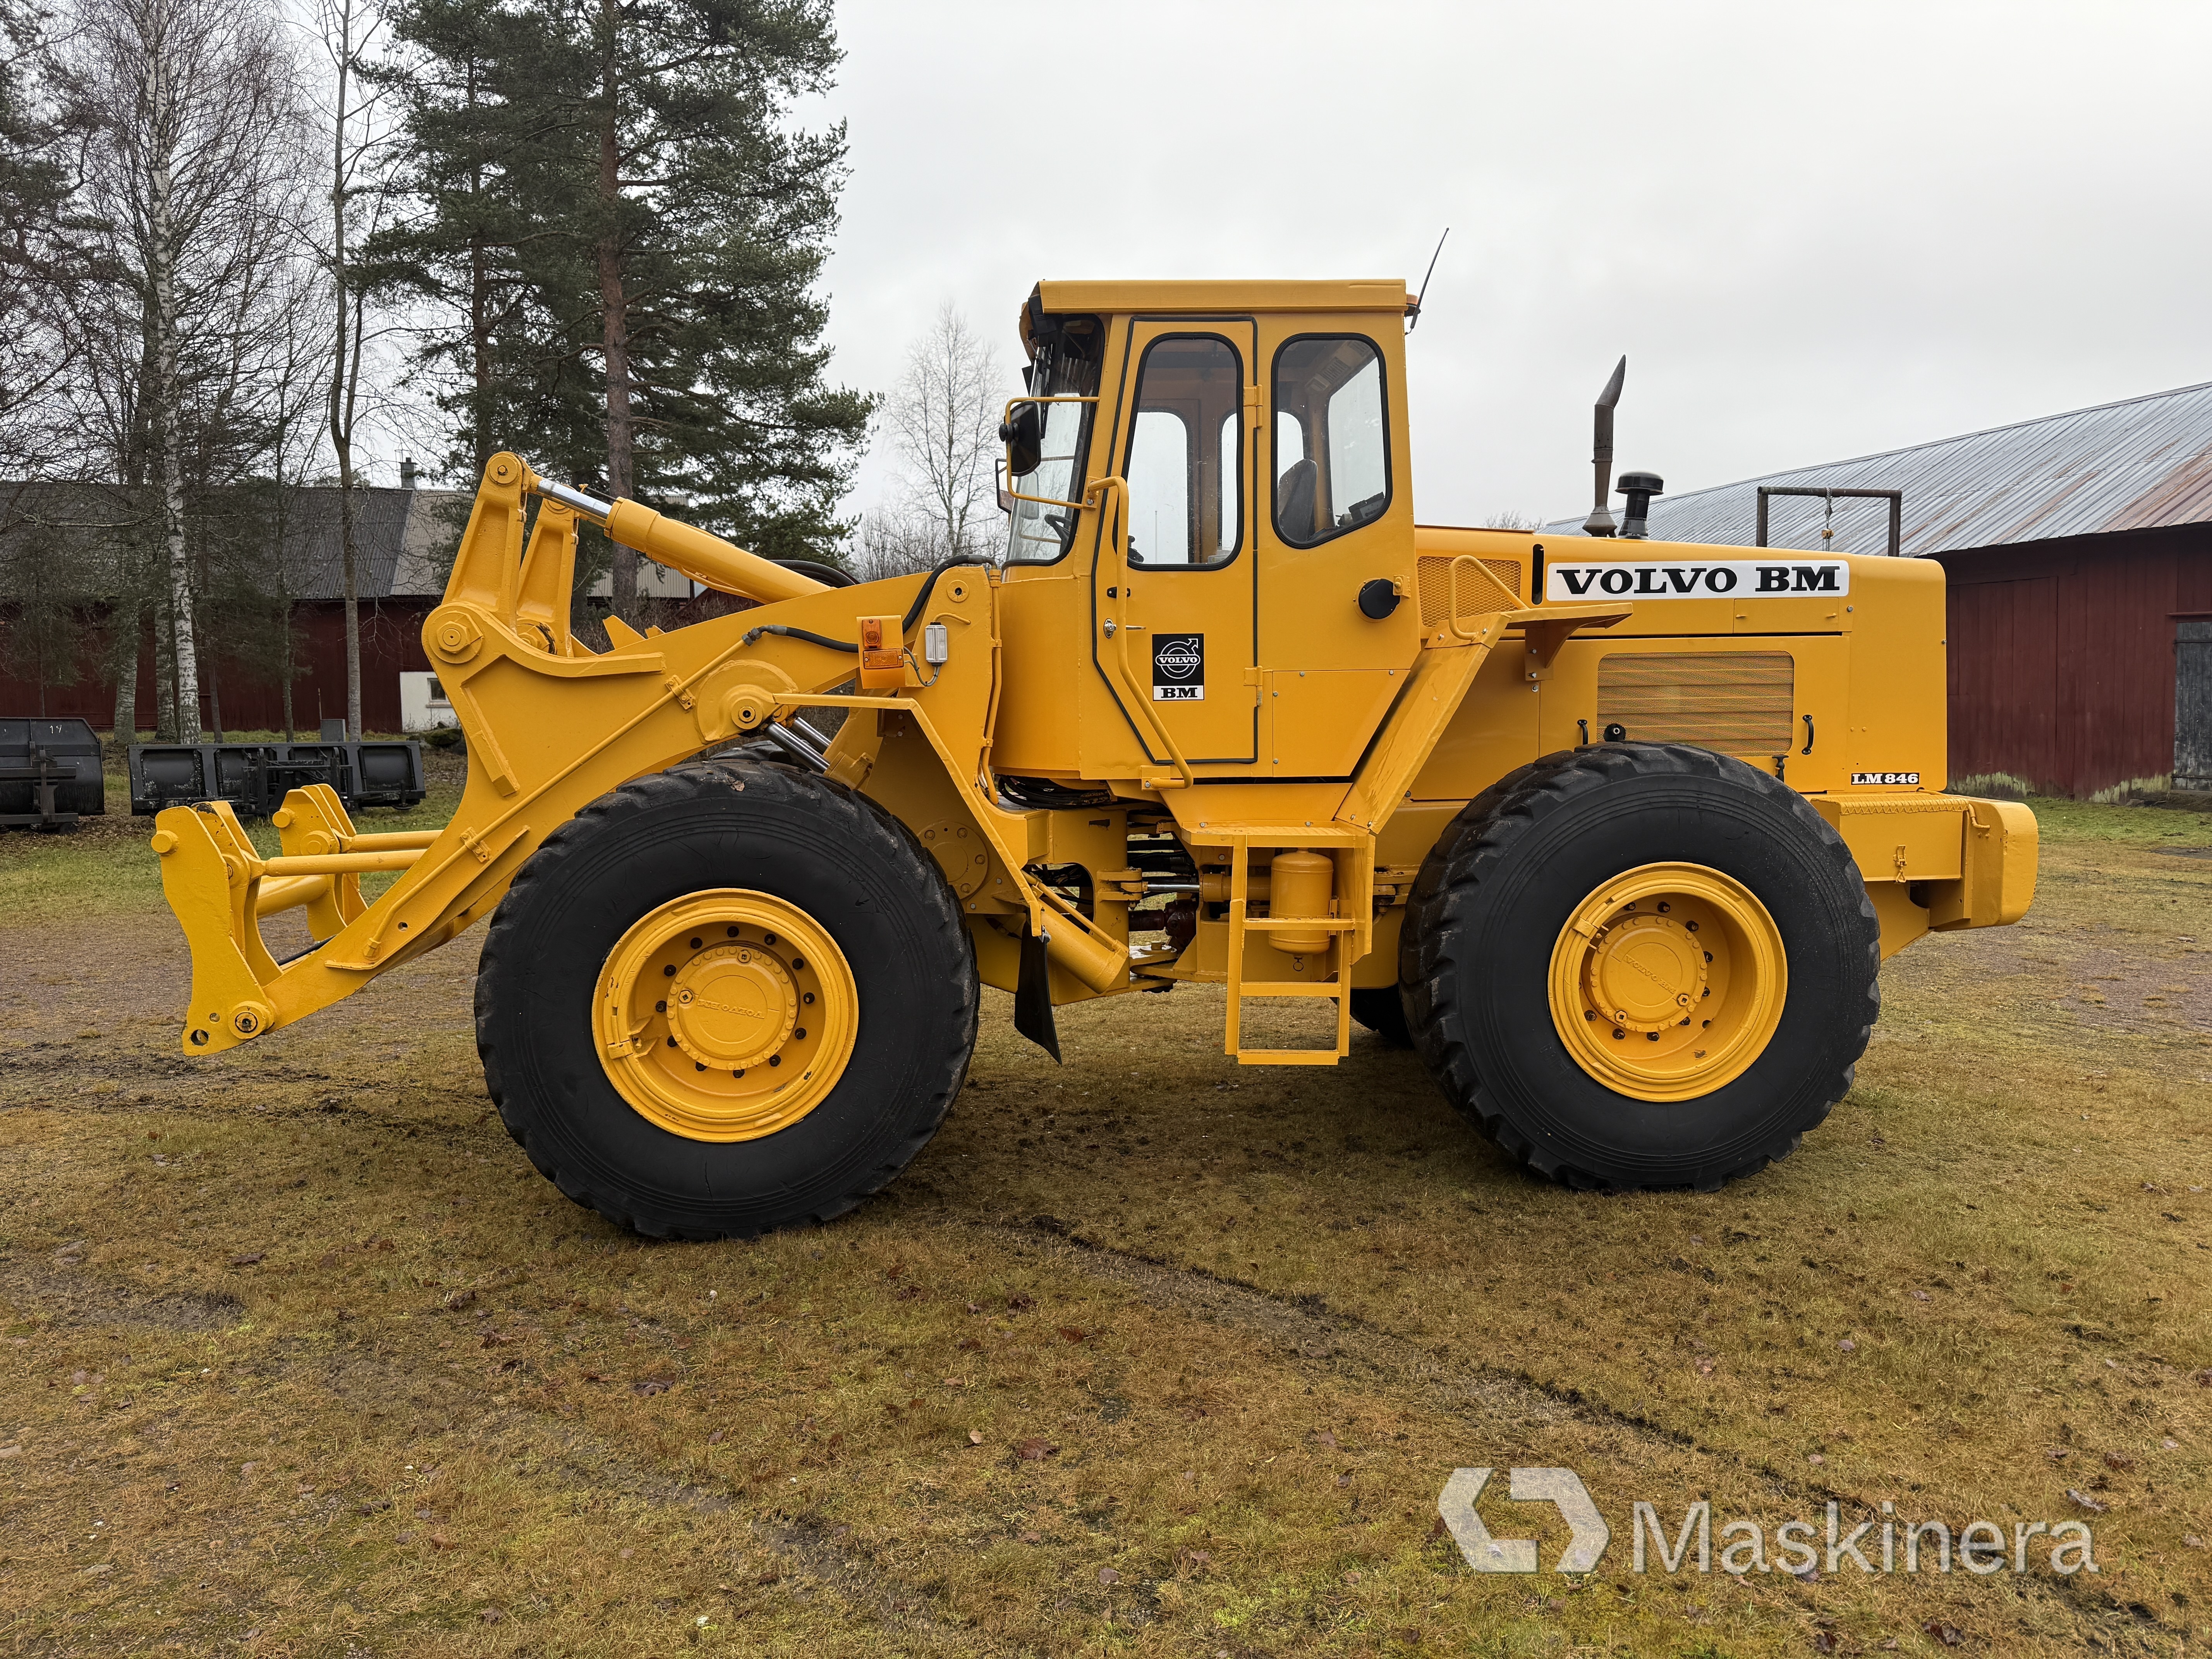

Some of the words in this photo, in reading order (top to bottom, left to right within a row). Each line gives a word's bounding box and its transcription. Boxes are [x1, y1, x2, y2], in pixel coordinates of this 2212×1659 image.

[1556, 567, 1738, 594] VOLVO
[1755, 566, 1840, 592] BM
[1161, 687, 1198, 698] BM
[1852, 773, 1883, 784] LM
[1884, 773, 1918, 784] 846
[1624, 954, 1659, 981] VOLVO
[1658, 978, 1677, 995] BM
[721, 1004, 765, 1019] VOLVO
